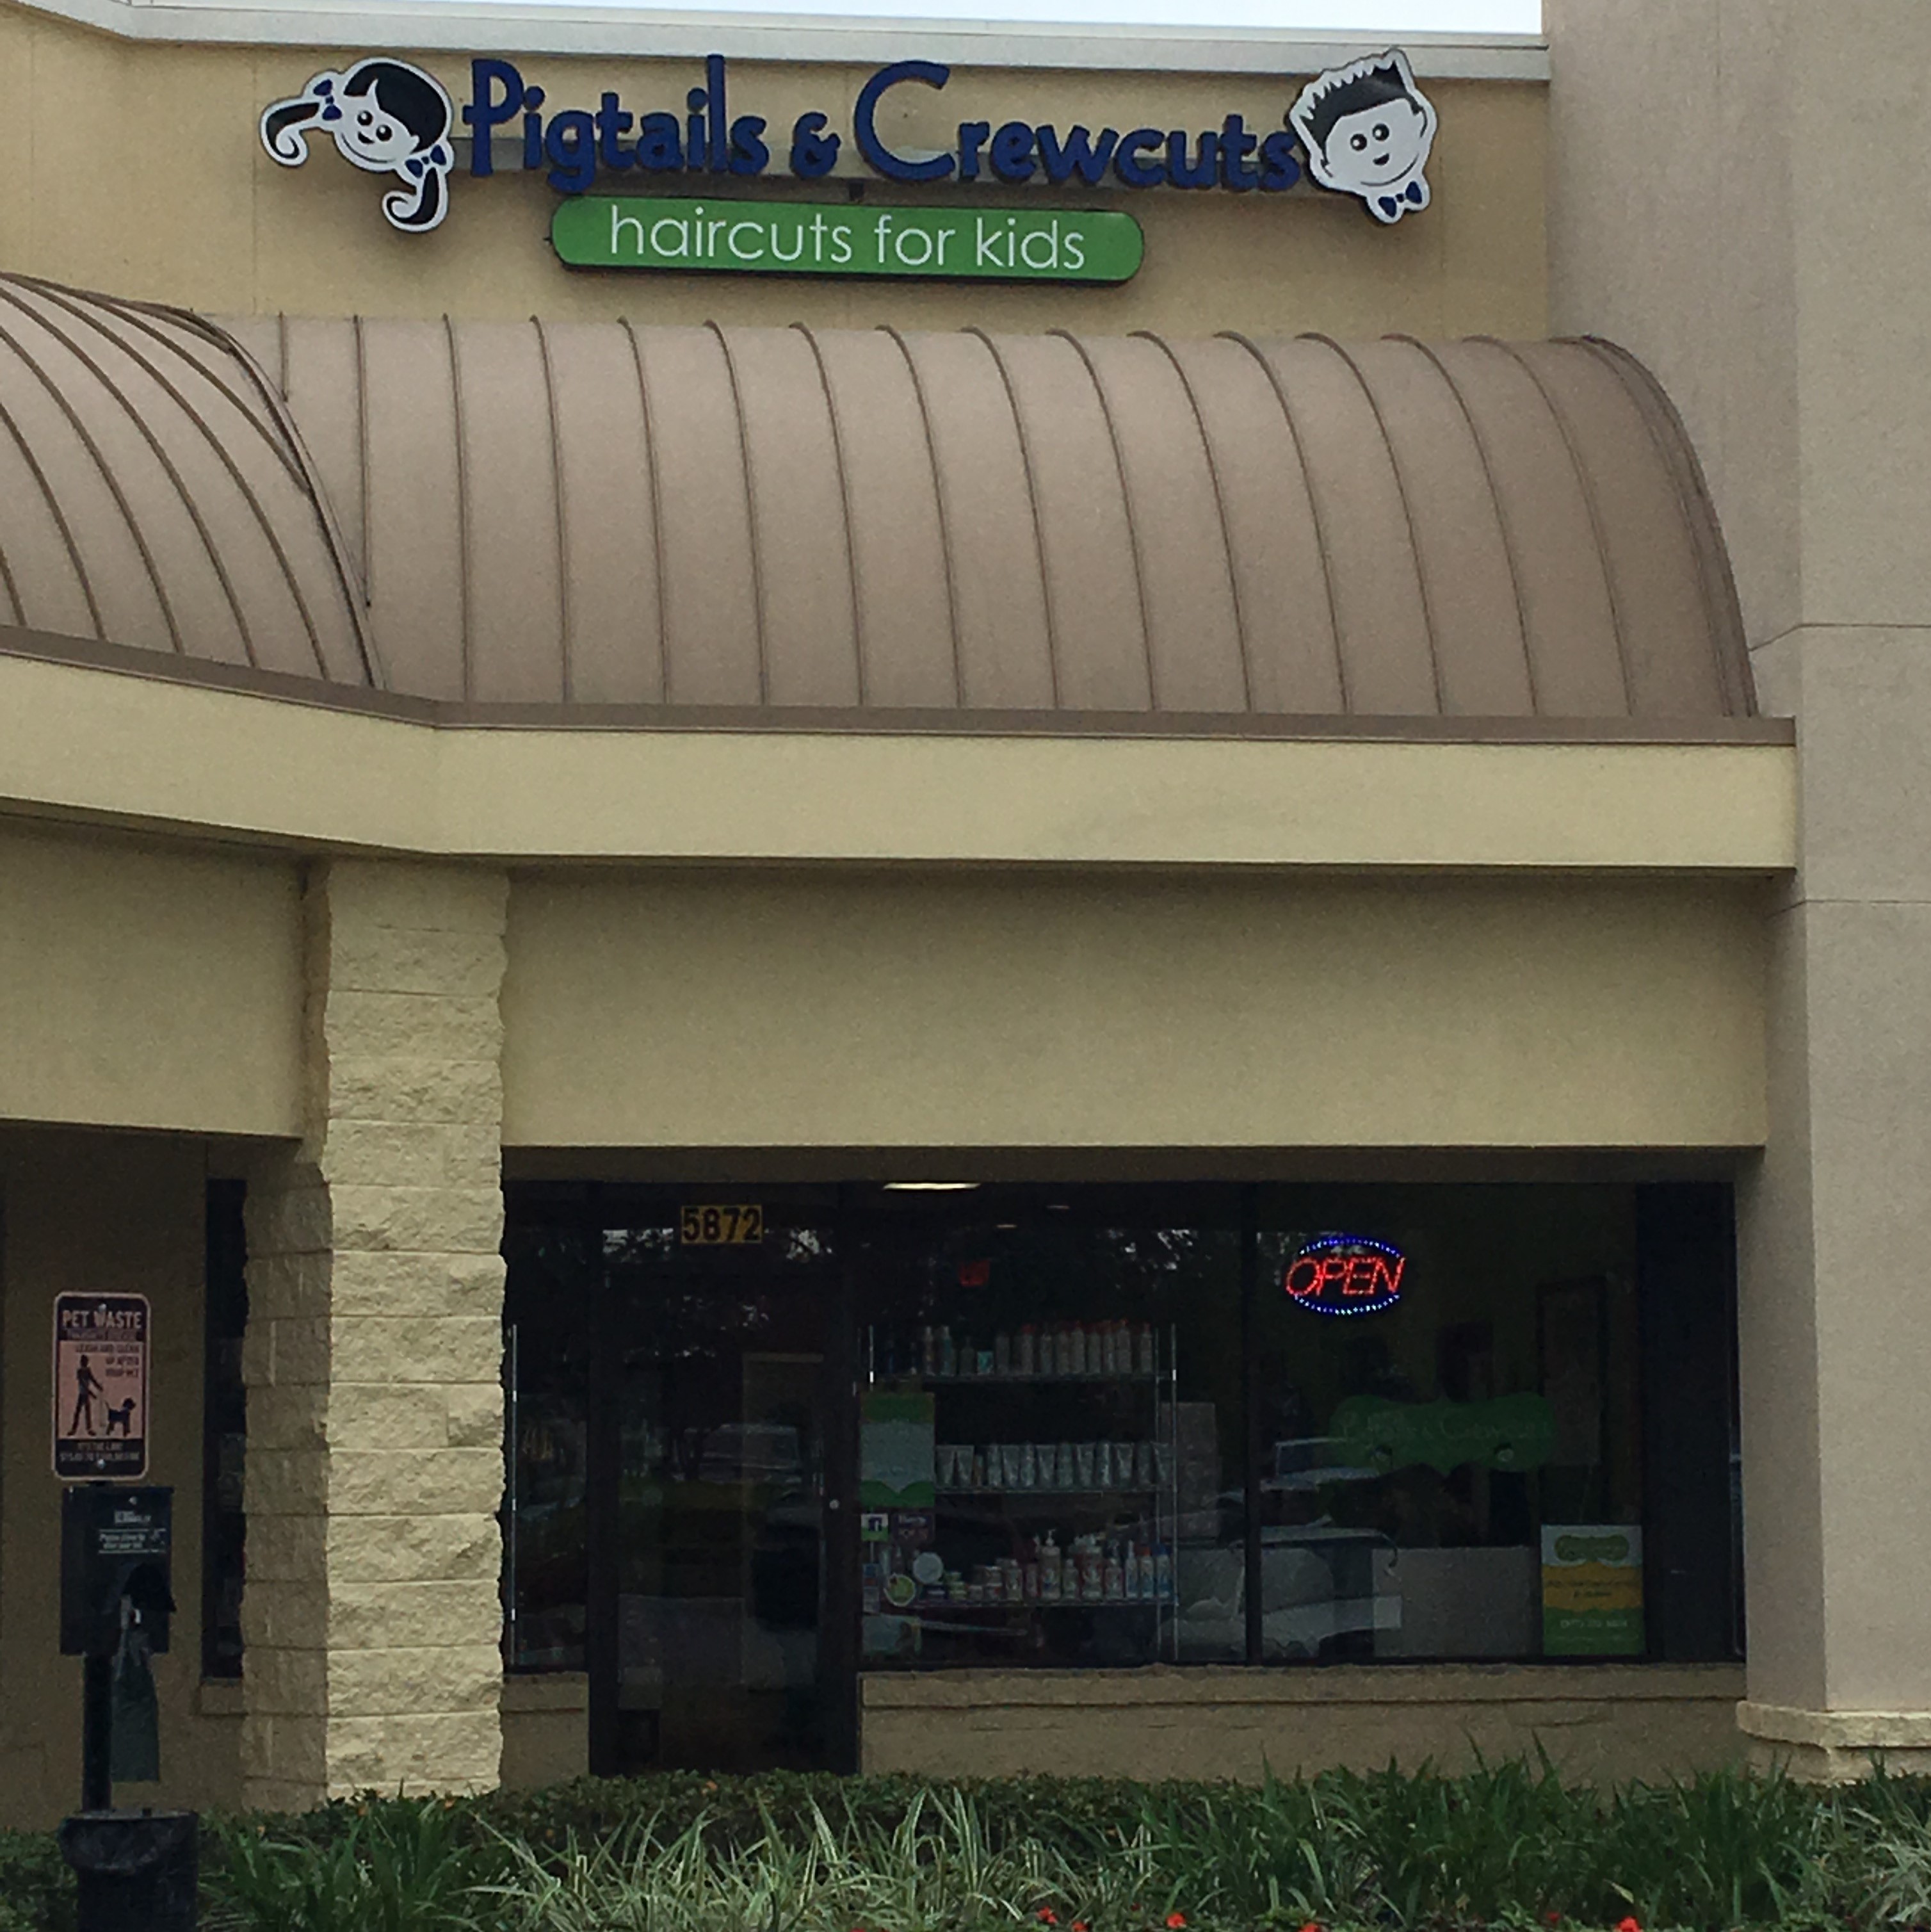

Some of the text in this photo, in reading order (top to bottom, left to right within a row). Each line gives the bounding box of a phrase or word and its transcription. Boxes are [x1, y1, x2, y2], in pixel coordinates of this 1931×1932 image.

[462, 53, 1301, 193] Pigtails & Crewcuts
[611, 205, 1085, 270] haircuts for kids
[683, 1207, 761, 1242] 5872
[1285, 1255, 1405, 1296] OPEN
[61, 1309, 142, 1329] PET WASTE
